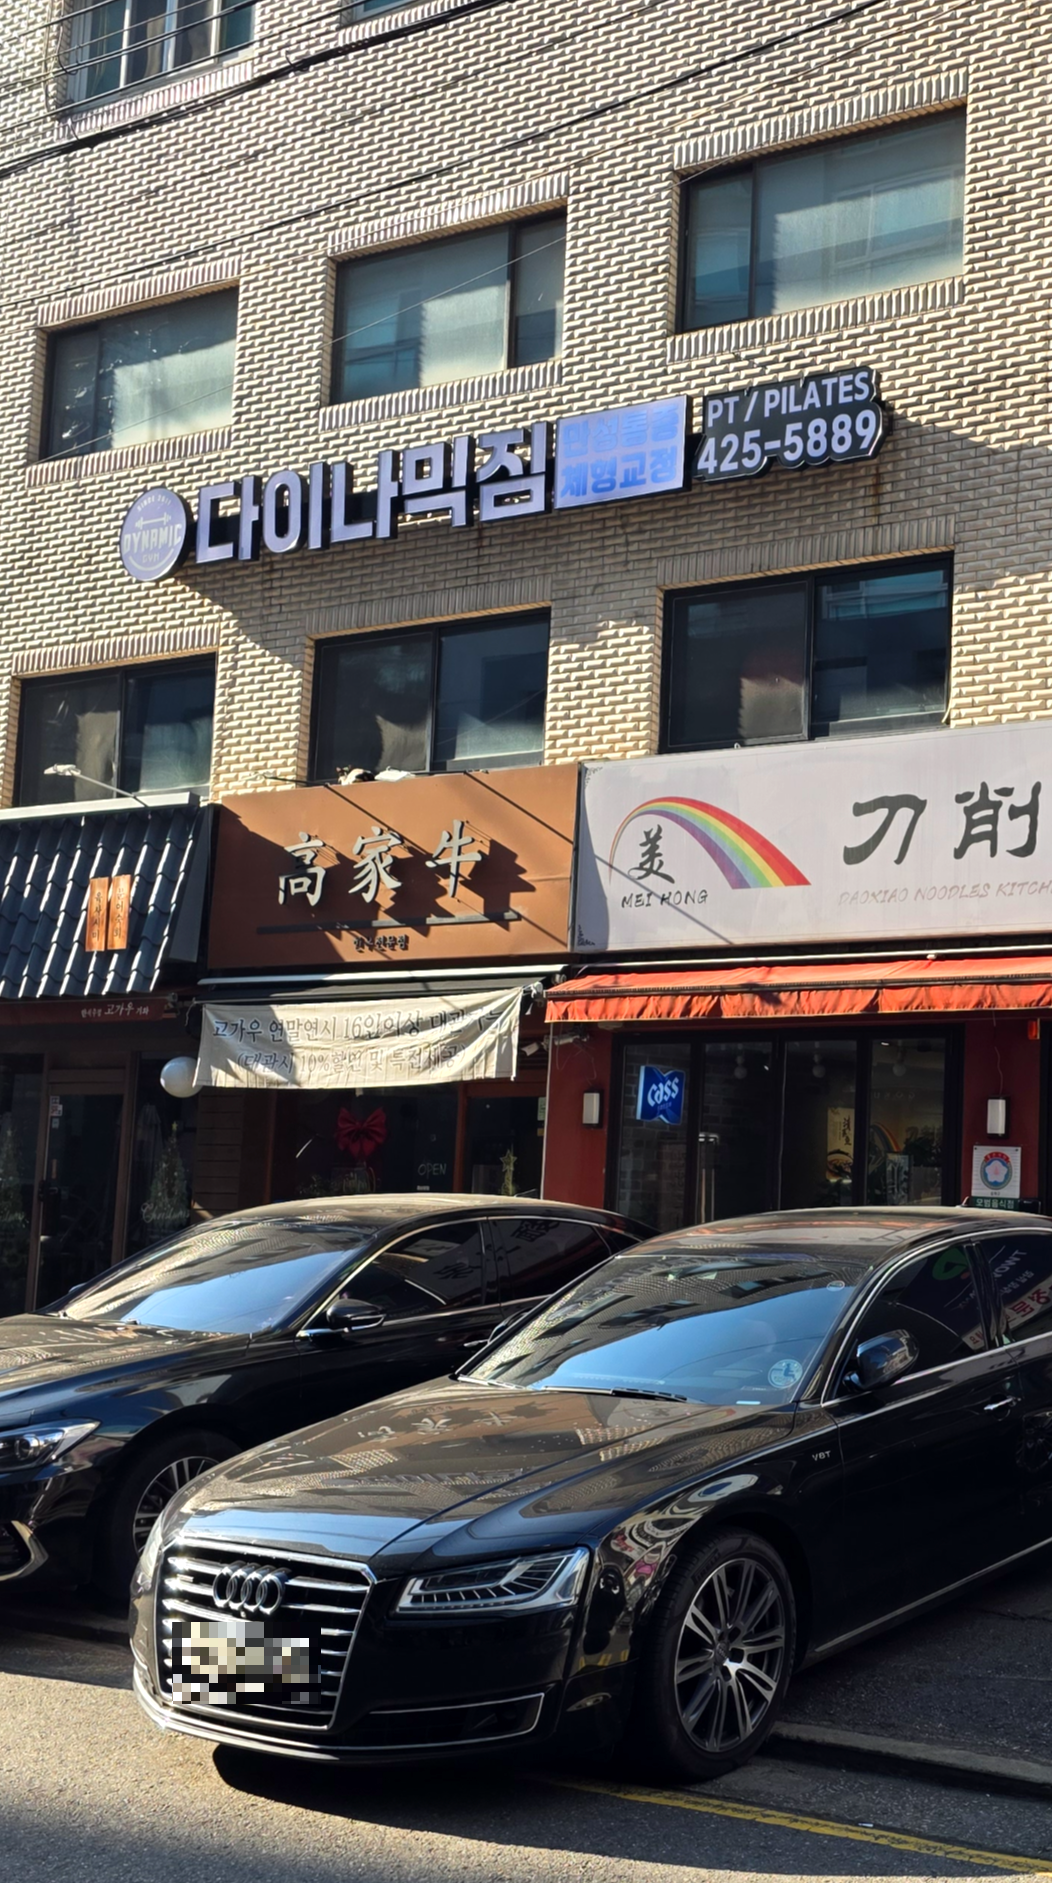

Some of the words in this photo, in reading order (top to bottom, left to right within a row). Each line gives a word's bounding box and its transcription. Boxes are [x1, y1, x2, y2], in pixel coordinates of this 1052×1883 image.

[708, 396, 739, 428] PT
[764, 371, 870, 418] PILATES
[563, 403, 680, 458] 만성통증
[697, 409, 877, 475] 425-5889
[560, 445, 678, 498] 체형교정
[196, 421, 548, 564] 다이나믹짐
[122, 523, 183, 556] DYNAMIC
[142, 553, 160, 563] GYM
[278, 818, 483, 907] 高家牛
[621, 893, 652, 908] MEI
[660, 889, 709, 906] HONG
[914, 882, 991, 902] NOODLES
[104, 1001, 135, 1016] 고가우
[212, 1018, 263, 1043] 고가우
[269, 1016, 337, 1043] 연말연시
[371, 1050, 385, 1072] 및
[418, 1163, 447, 1178] OPEN
